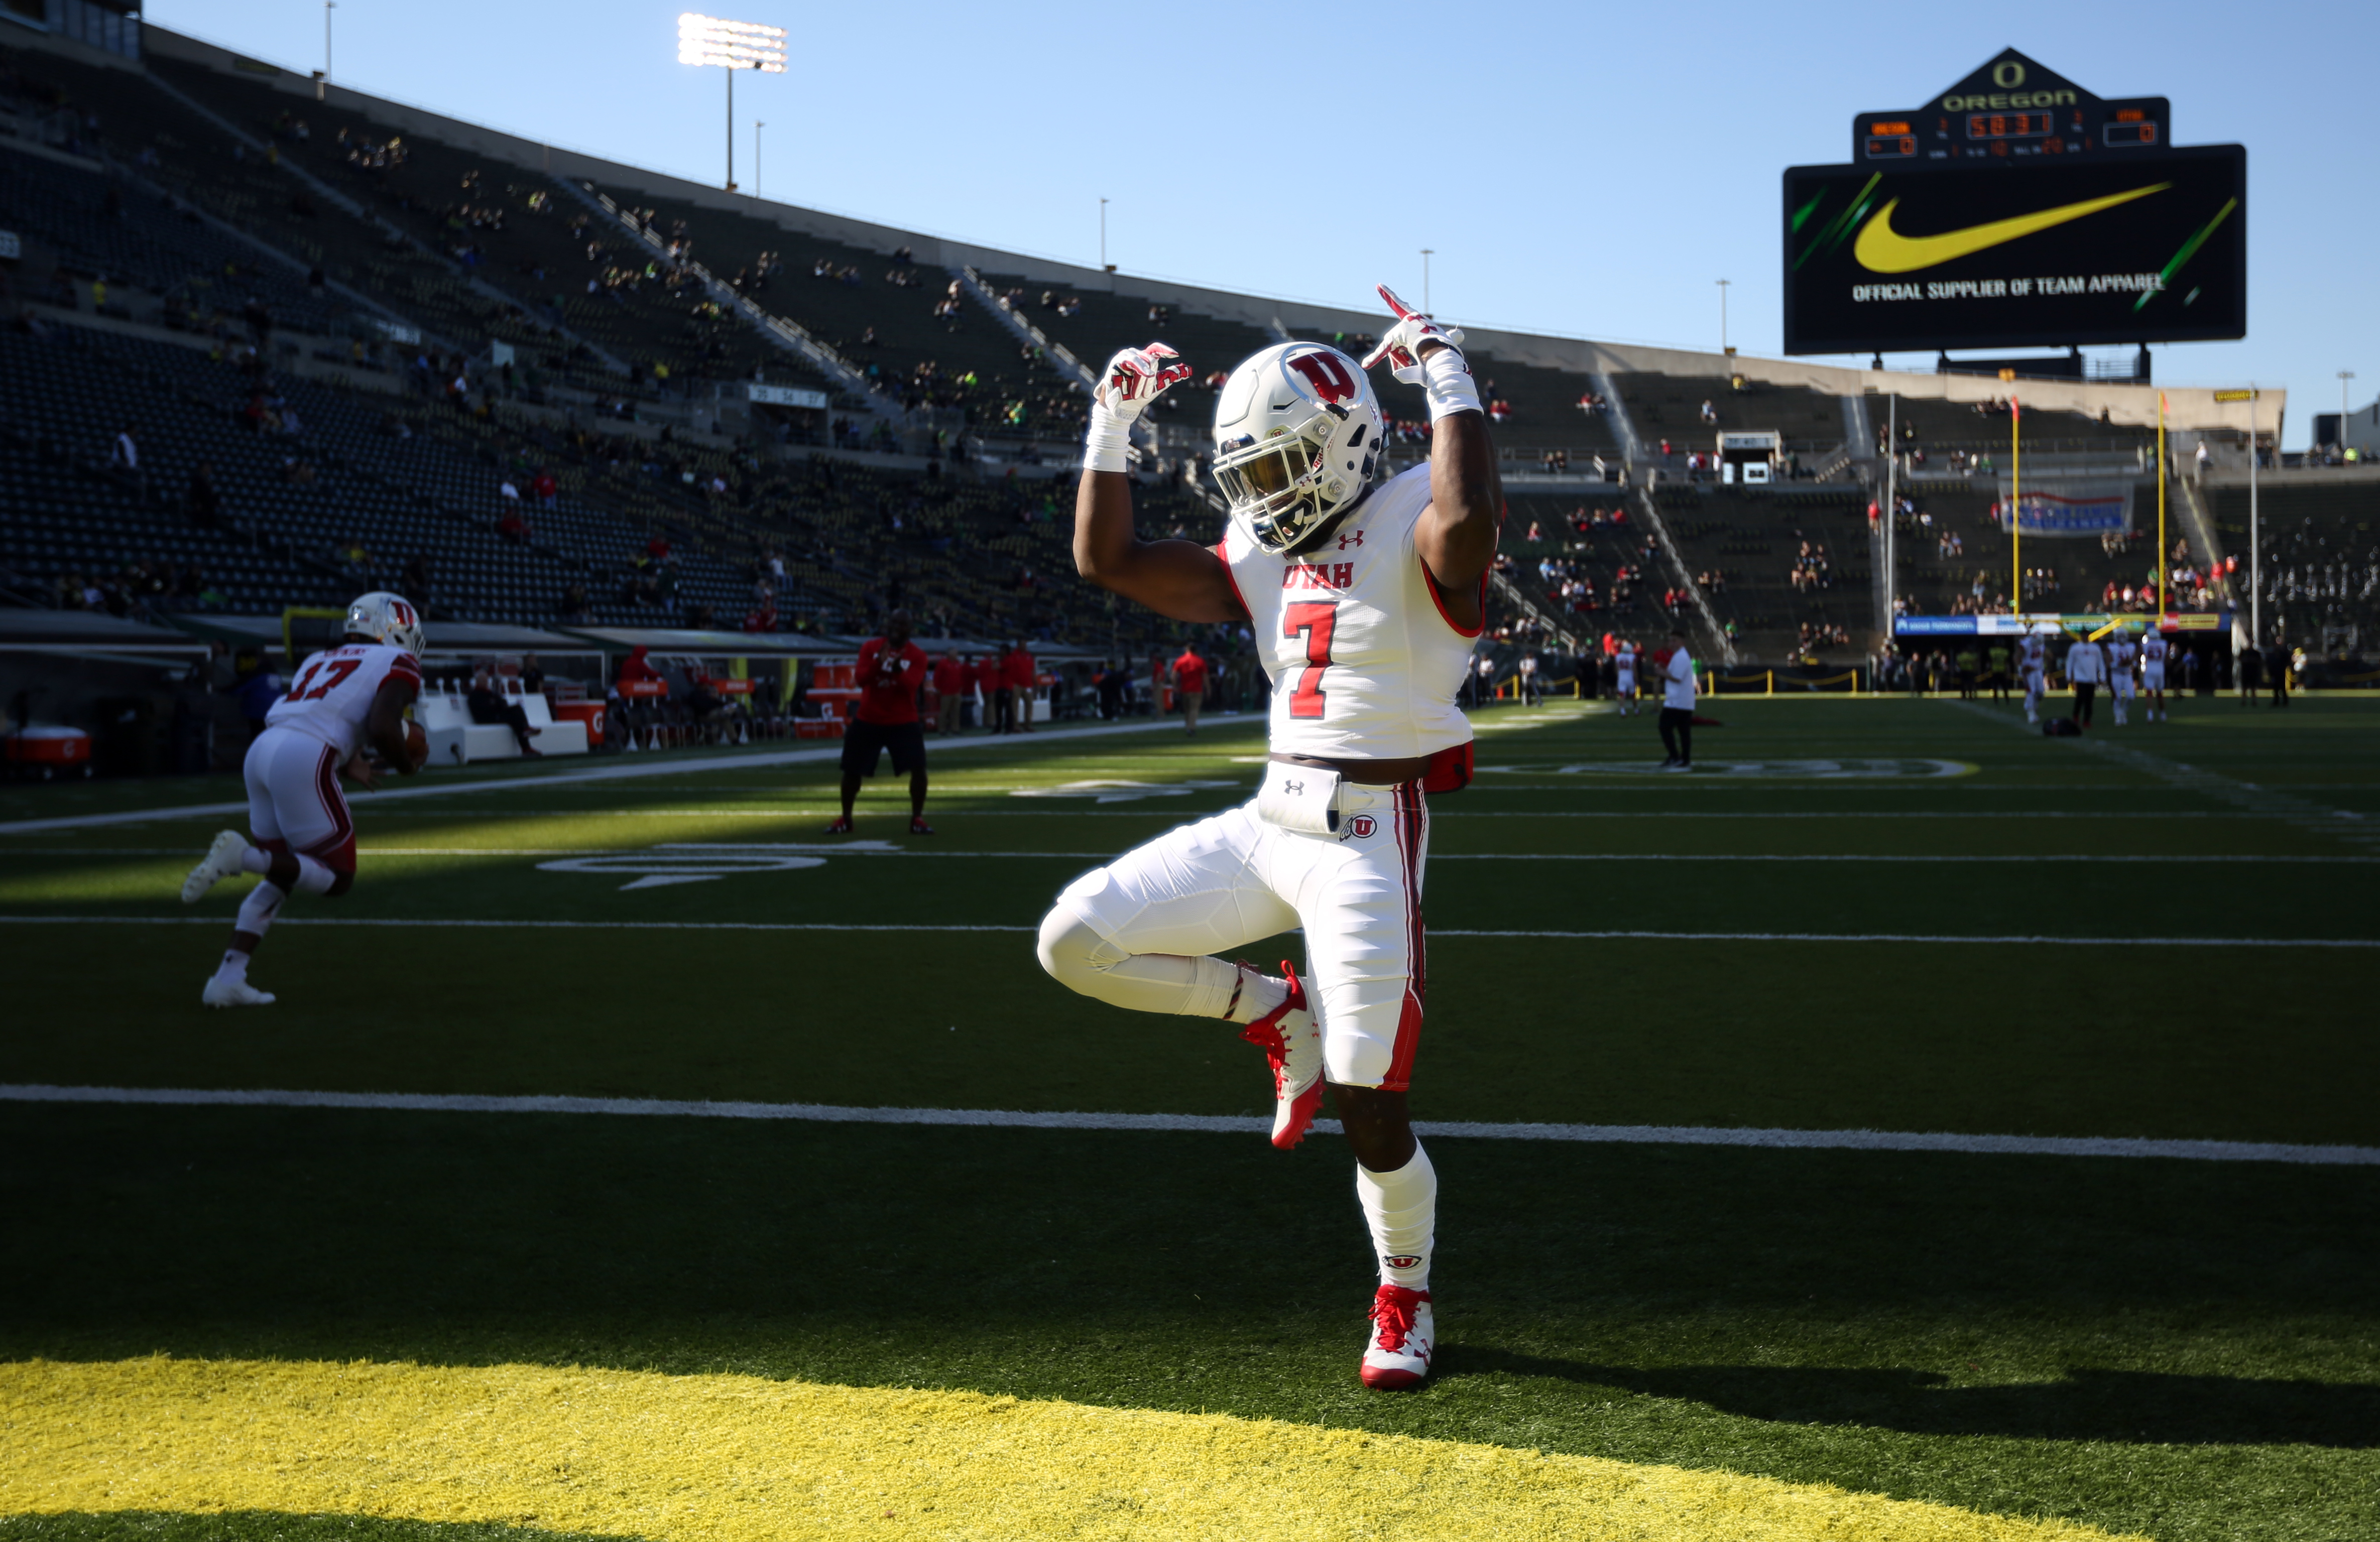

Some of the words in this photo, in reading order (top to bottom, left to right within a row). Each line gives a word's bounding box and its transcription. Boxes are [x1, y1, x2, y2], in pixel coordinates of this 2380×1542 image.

[1993, 60, 2026, 88] O
[1942, 89, 2077, 112] OREGON
[1853, 282, 1924, 302] OFFICIAL
[1927, 279, 2006, 299] SUPPLIER
[2010, 278, 2033, 296] OF
[2035, 276, 2084, 295] TEAM
[2088, 273, 2166, 293] APPAREL
[1282, 562, 1353, 589] UTAH
[1283, 601, 1340, 720] 7
[285, 660, 362, 702] 17
[1354, 819, 1372, 835] U
[1392, 1258, 1413, 1267] U
